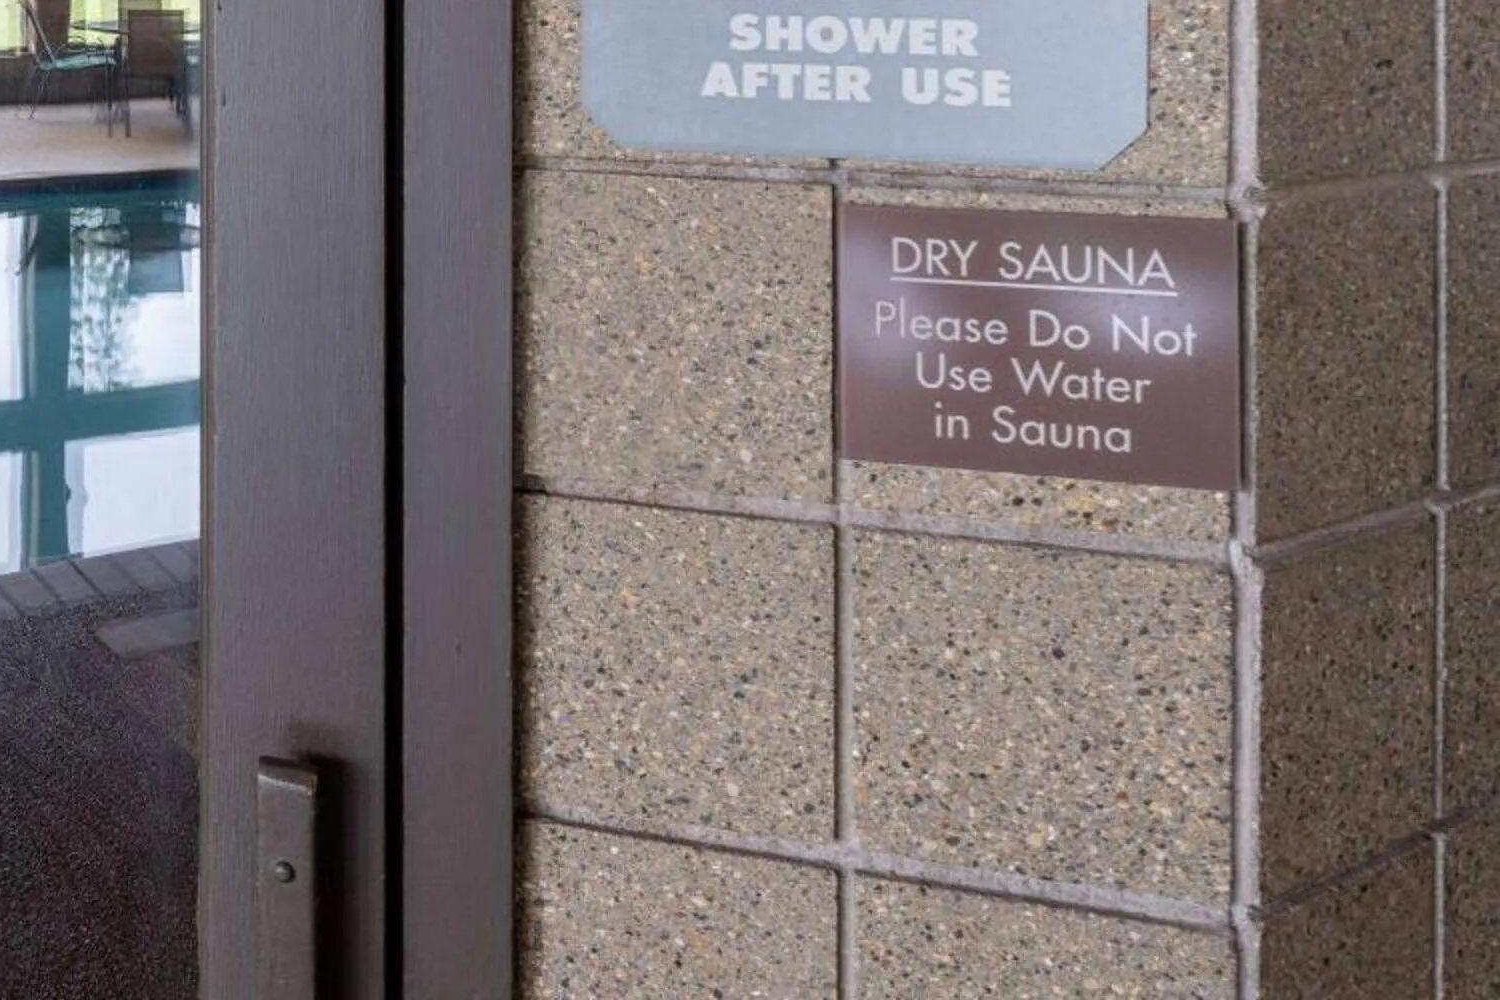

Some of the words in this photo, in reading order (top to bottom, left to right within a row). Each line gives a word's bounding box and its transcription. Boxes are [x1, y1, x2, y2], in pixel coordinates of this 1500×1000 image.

[729, 15, 980, 57] SHOWER
[701, 62, 873, 104] AFTER
[901, 68, 1012, 107] USE
[890, 237, 978, 277] DRY
[998, 241, 1176, 288] SAUNA
[875, 297, 1009, 345] Please
[1028, 309, 1090, 351] Do
[1111, 314, 1198, 357] Not
[915, 352, 993, 392] Use
[1011, 358, 1152, 404] Water
[934, 402, 970, 440] in
[991, 406, 1133, 454] Sauna
